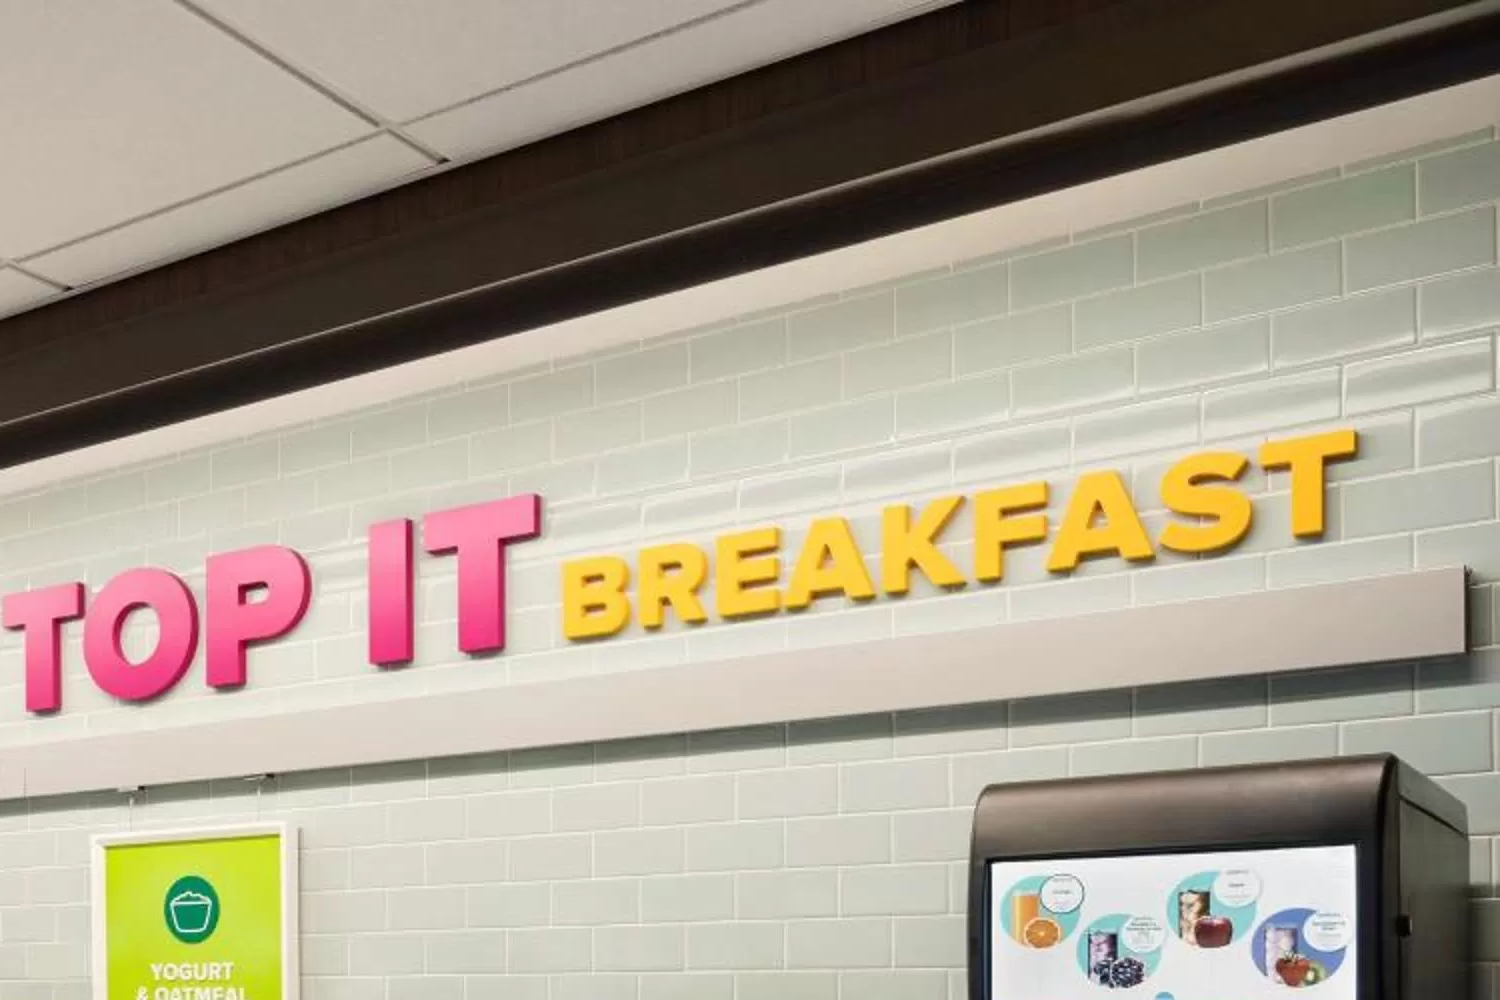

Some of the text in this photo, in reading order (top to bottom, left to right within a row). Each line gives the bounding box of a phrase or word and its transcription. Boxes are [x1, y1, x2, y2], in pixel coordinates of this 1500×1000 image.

[2, 429, 1358, 714] TOP IT BREAKFAST
[150, 962, 235, 981] YOGURT
